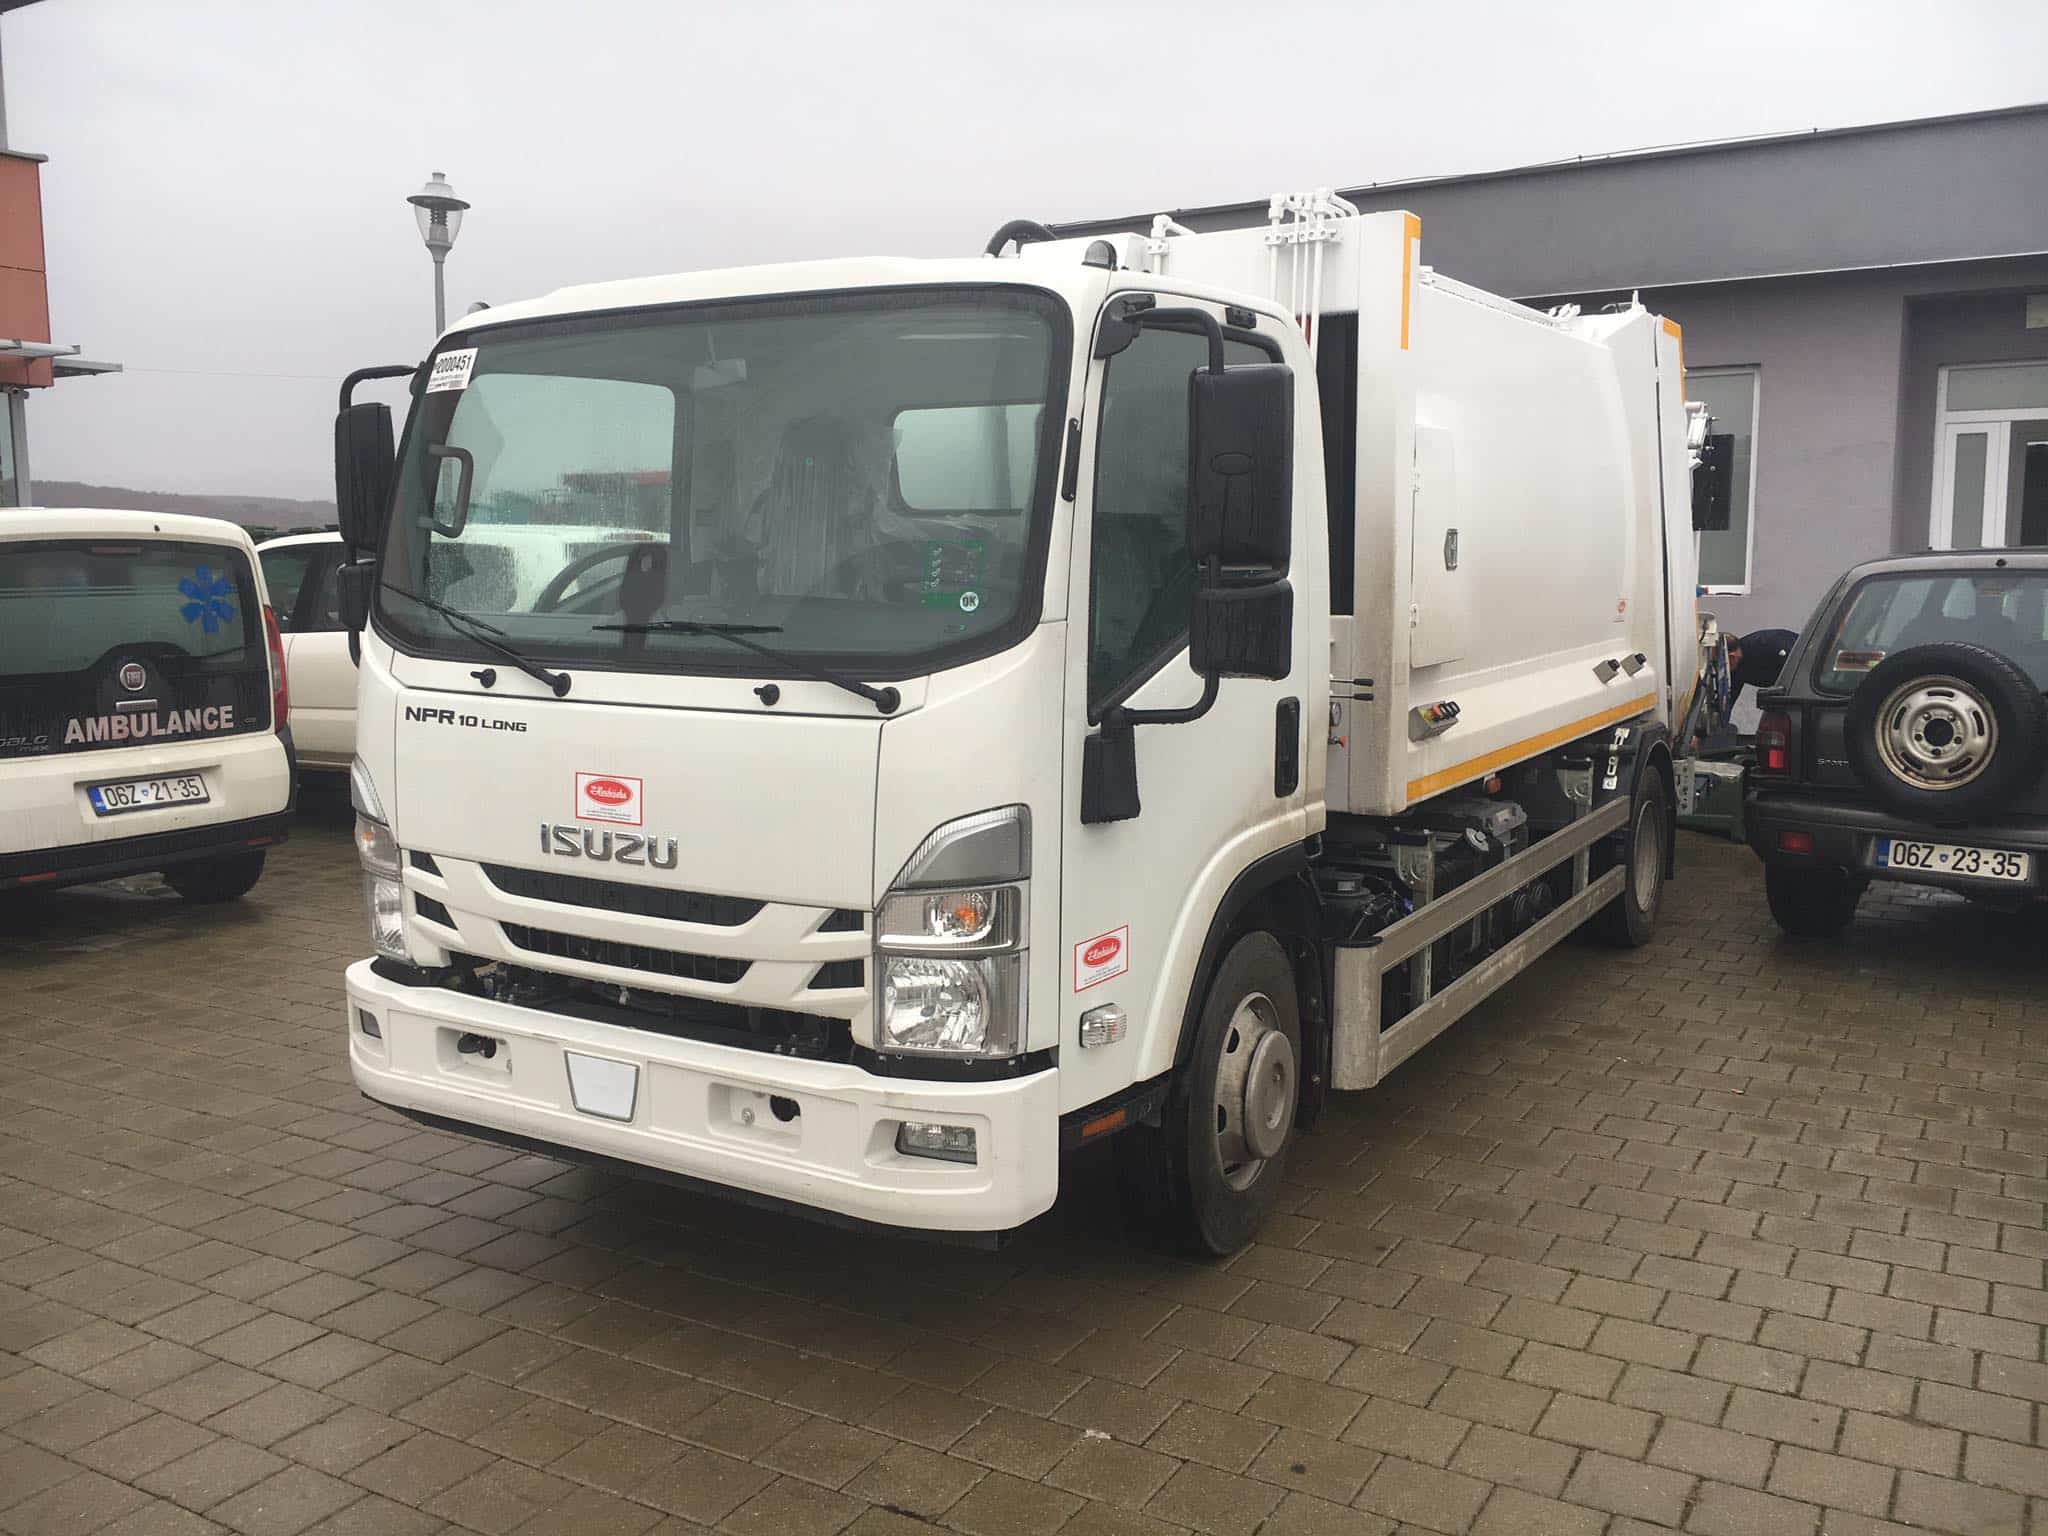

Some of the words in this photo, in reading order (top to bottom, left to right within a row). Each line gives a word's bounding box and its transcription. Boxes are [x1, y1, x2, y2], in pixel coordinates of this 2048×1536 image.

[962, 595, 977, 608] OK
[64, 705, 235, 745] AMBULANCE
[405, 706, 455, 725] NPR
[459, 714, 478, 728] 10
[481, 719, 528, 733] LONG
[104, 784, 141, 807] 06Z
[150, 778, 201, 801] 21-35
[540, 822, 679, 870] ISUZU
[1893, 842, 1935, 869] 06Z
[1951, 848, 2023, 878] 23-35
